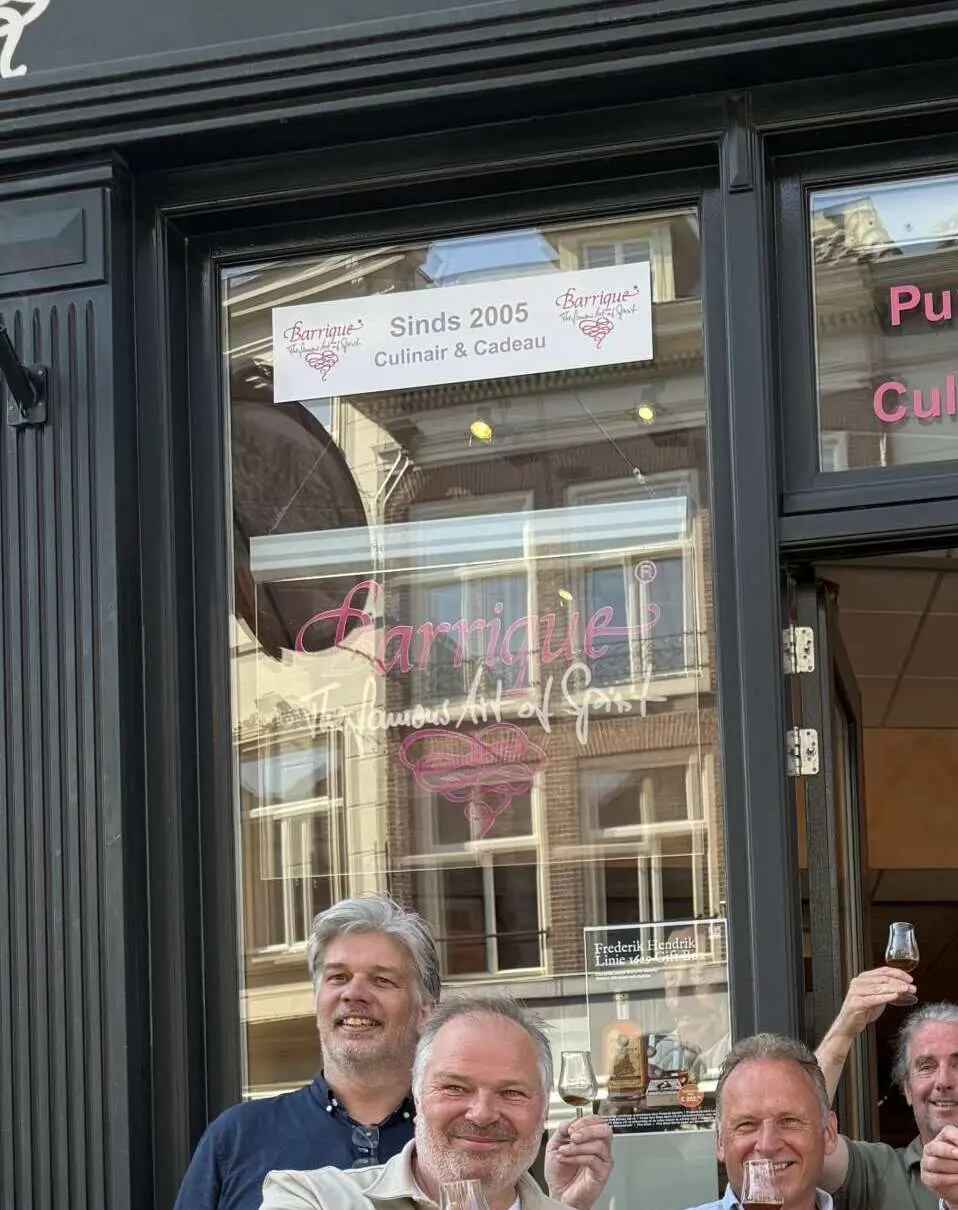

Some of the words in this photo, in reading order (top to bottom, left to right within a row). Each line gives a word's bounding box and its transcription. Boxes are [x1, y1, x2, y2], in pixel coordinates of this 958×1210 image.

[555, 286, 640, 310] Barrique
[283, 320, 364, 342] Barrique
[389, 311, 461, 338] Sinds
[469, 301, 529, 329] 2005
[374, 345, 448, 367] Culinair
[454, 342, 468, 359] &
[473, 335, 547, 356] Cadeau
[295, 579, 661, 697] Barrique
[456, 664, 506, 729] Art
[518, 675, 554, 734] of
[594, 939, 644, 956] Frederik
[647, 936, 697, 952] Hendrik
[595, 953, 626, 967] Linie
